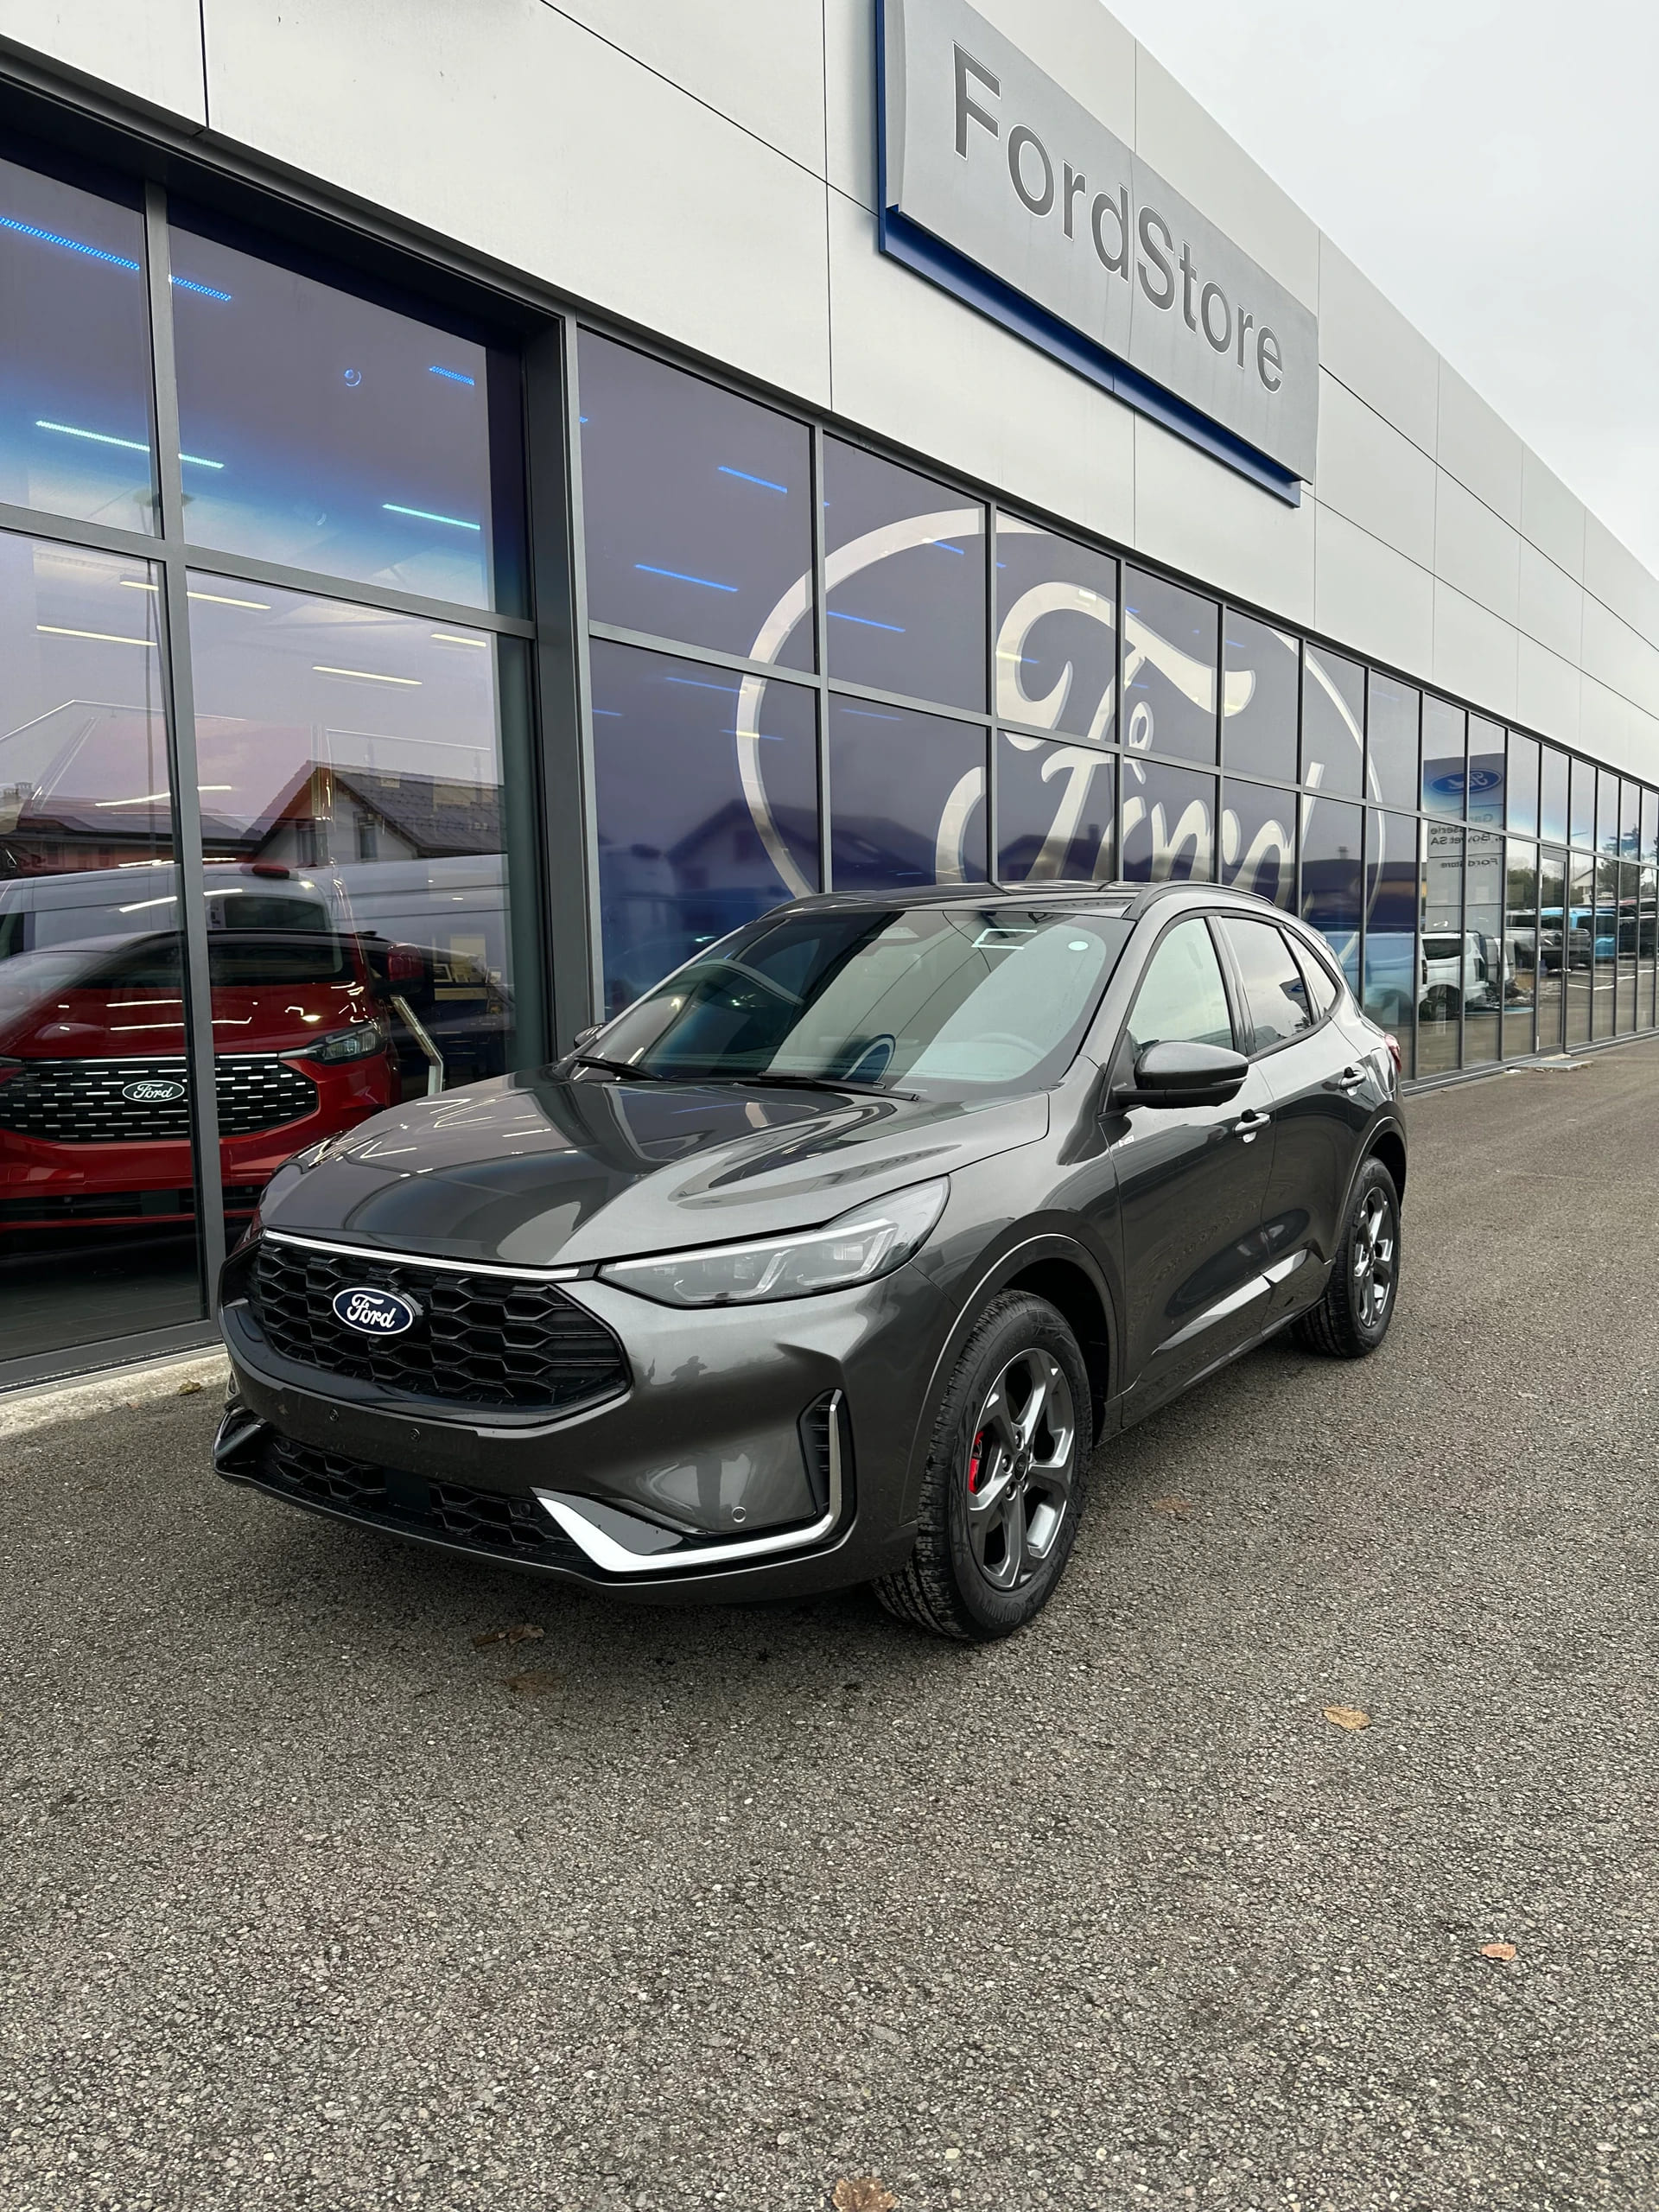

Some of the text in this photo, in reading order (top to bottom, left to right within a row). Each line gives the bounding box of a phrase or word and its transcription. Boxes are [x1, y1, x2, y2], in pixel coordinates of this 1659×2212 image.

[952, 40, 1283, 394] FordStore
[133, 1084, 174, 1098] Ford
[346, 1294, 397, 1328] Ford
